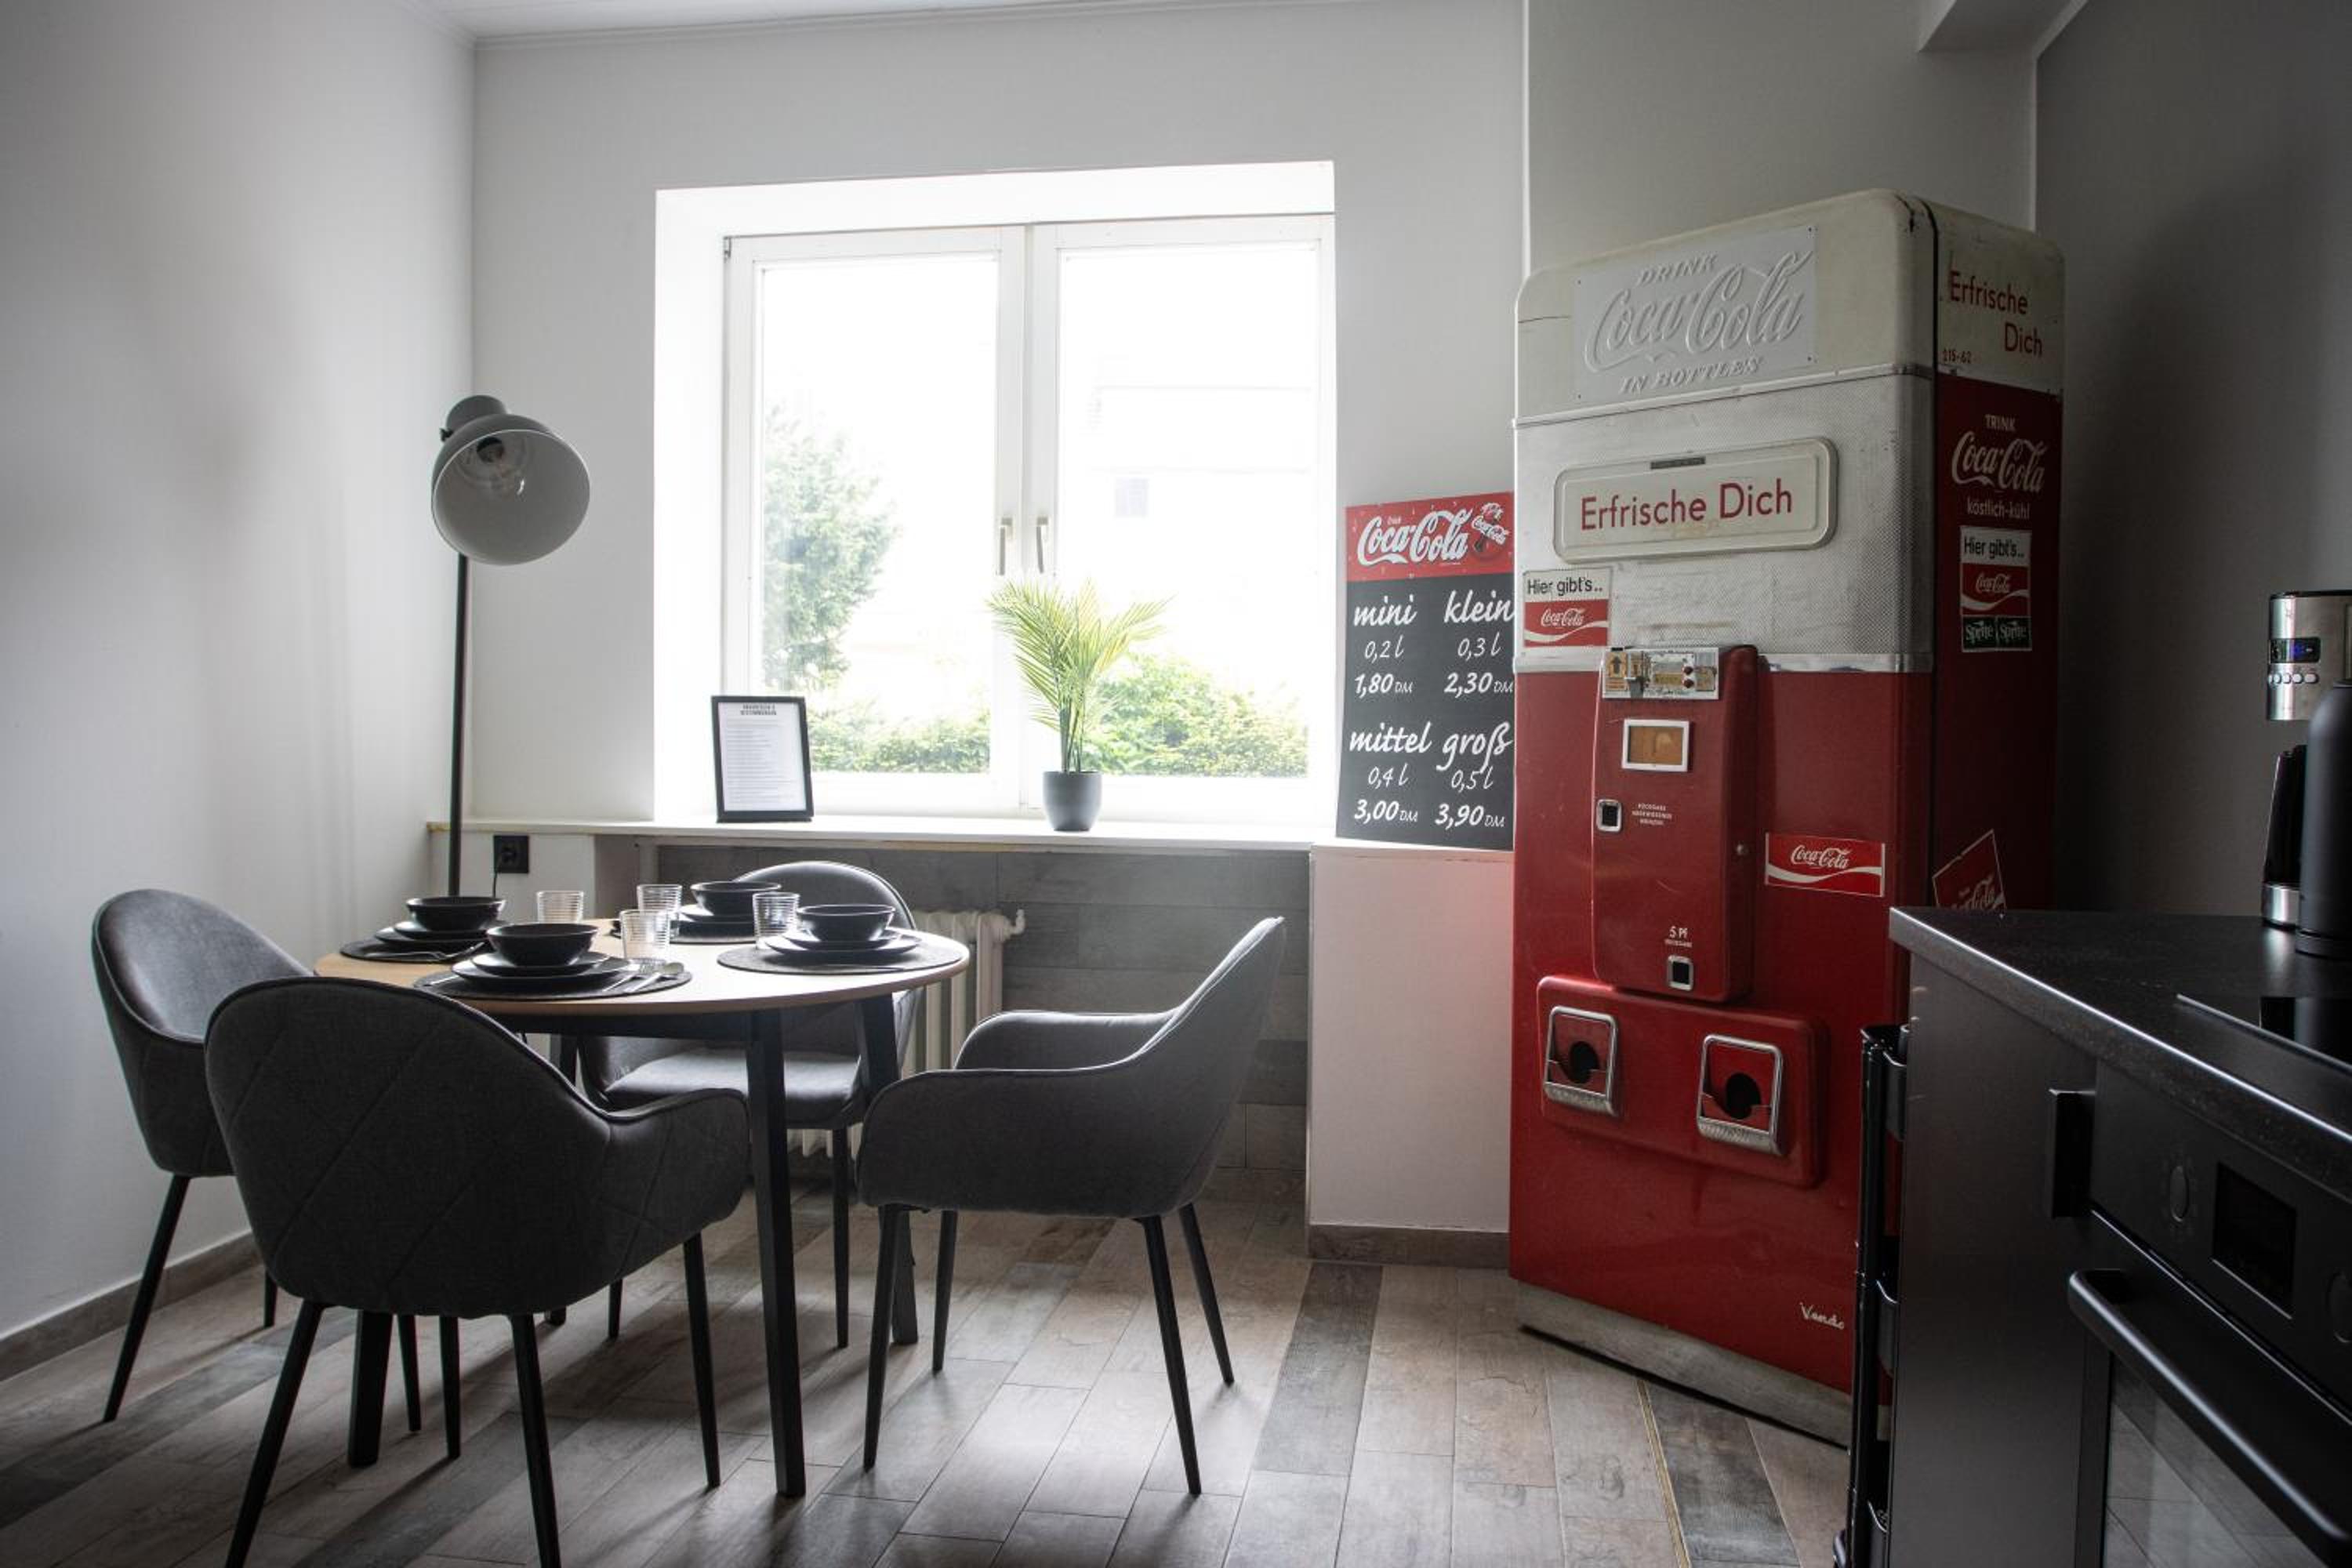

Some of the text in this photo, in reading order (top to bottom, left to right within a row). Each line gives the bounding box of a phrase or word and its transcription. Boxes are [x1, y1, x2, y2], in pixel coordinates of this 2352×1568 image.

[1636, 252, 1719, 286] DRINK
[1950, 270, 2028, 314] Erfrische
[2005, 322, 2042, 355] Dich
[1619, 357, 1764, 394] IN BOTTLES
[1984, 414, 2016, 432] TRINK
[1581, 478, 1792, 531] Erfrische Dich
[1964, 536, 1985, 555] Hier
[1526, 579, 1553, 594] Hier
[1354, 590, 1513, 626] mini klein
[1364, 639, 1391, 659] 0,2
[1457, 637, 1486, 659] 0,3
[1349, 721, 1513, 774] mittel groß
[1368, 767, 1392, 788] 0,4
[1451, 769, 1477, 792] 0,5
